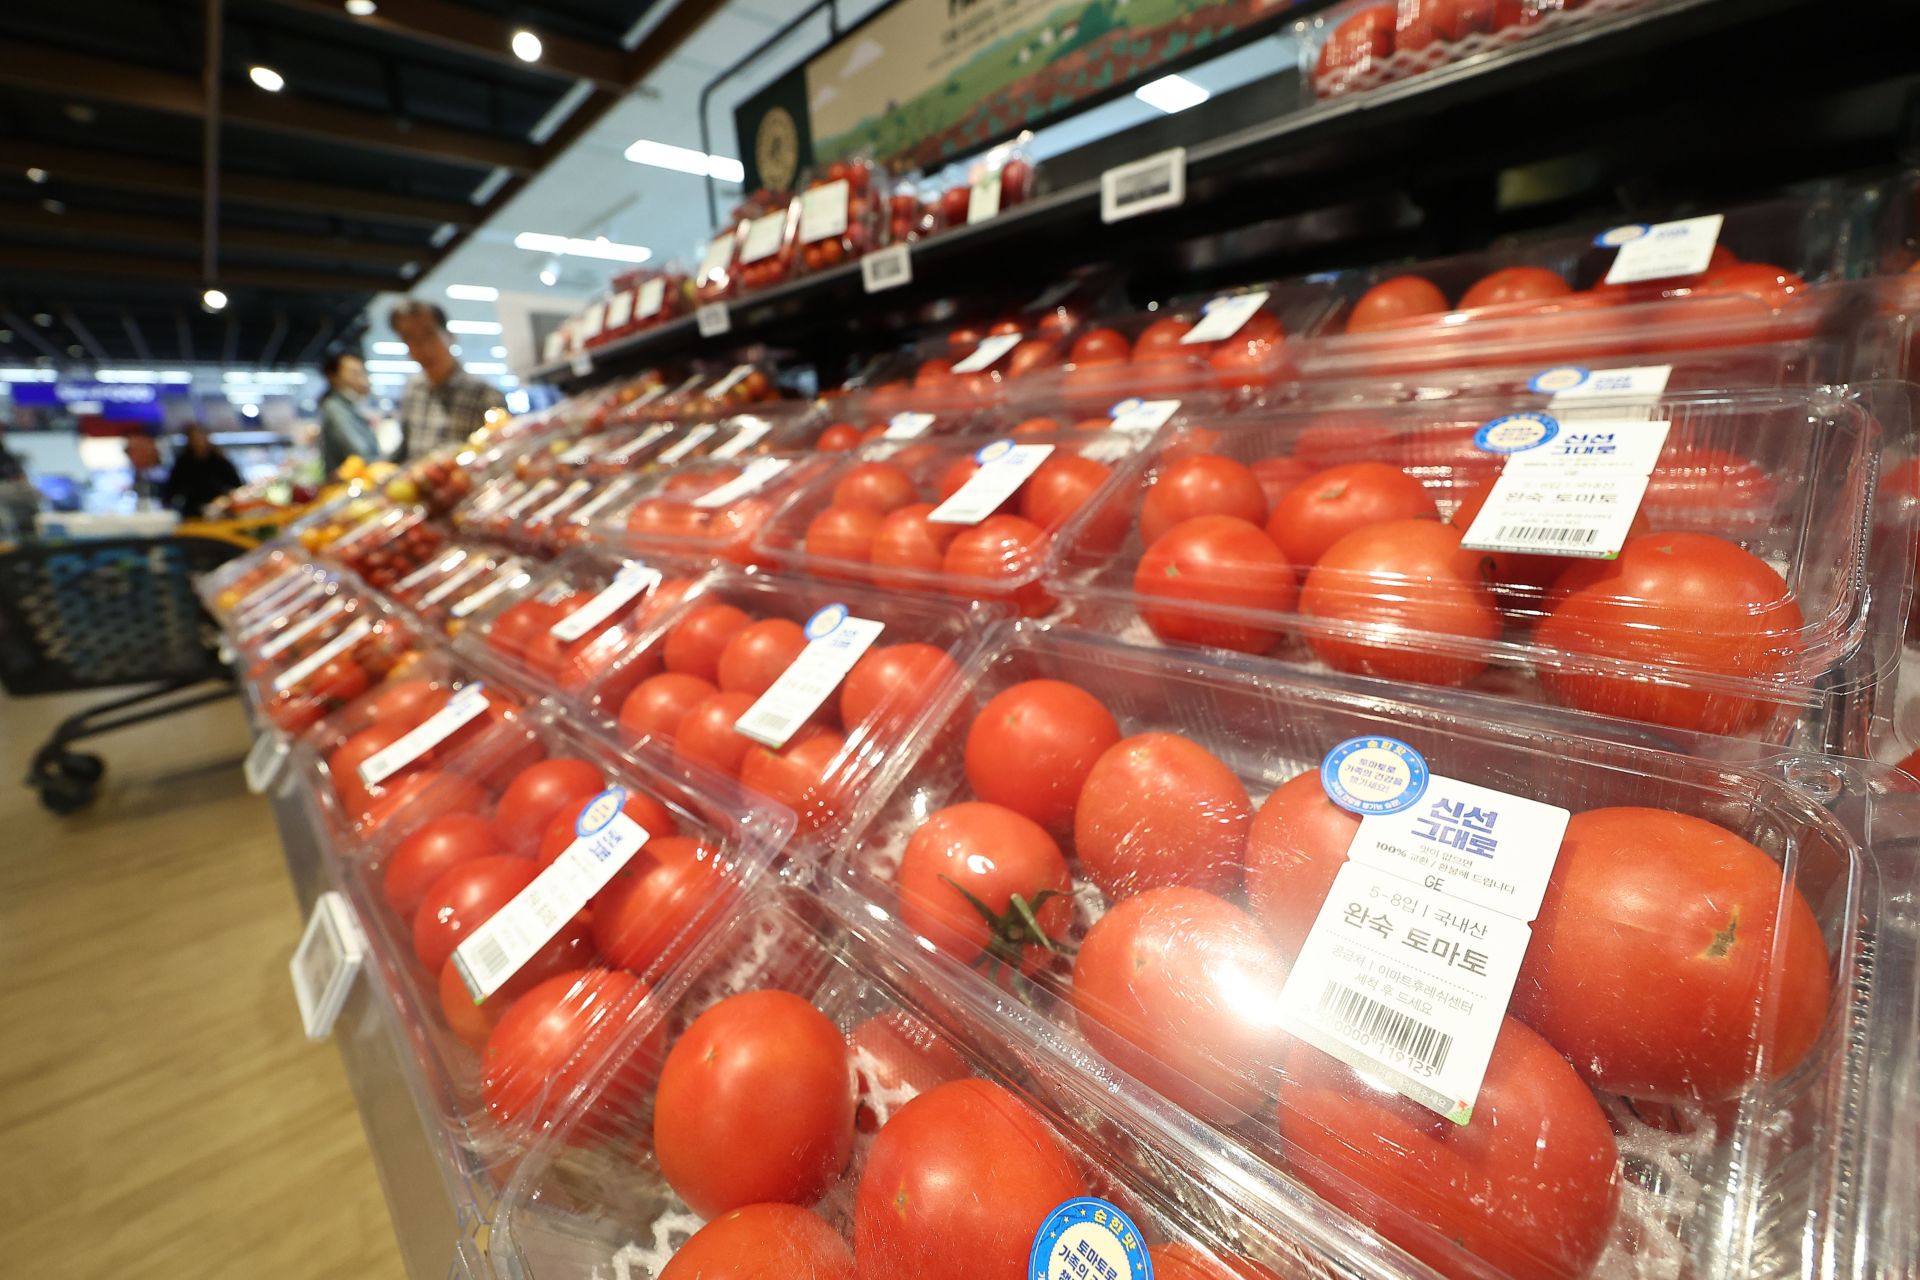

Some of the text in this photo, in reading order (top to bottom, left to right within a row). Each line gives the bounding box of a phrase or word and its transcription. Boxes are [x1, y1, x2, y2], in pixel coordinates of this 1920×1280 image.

[1430, 797, 1498, 835] 신선
[1411, 817, 1498, 859] 그대로
[1376, 840, 1407, 859] 100%
[1410, 853, 1429, 866] 교환
[1473, 873, 1516, 895] 드립니다
[1424, 874, 1445, 892] GE
[1369, 885, 1418, 914] 5-8입
[1434, 908, 1489, 940] 국내산
[1343, 902, 1490, 978] 완숙 토마토
[1354, 972, 1433, 1016] 세척 후 드세요
[1058, 1244, 1090, 1280] 가족의
[1076, 1239, 1118, 1280] 토마토로
